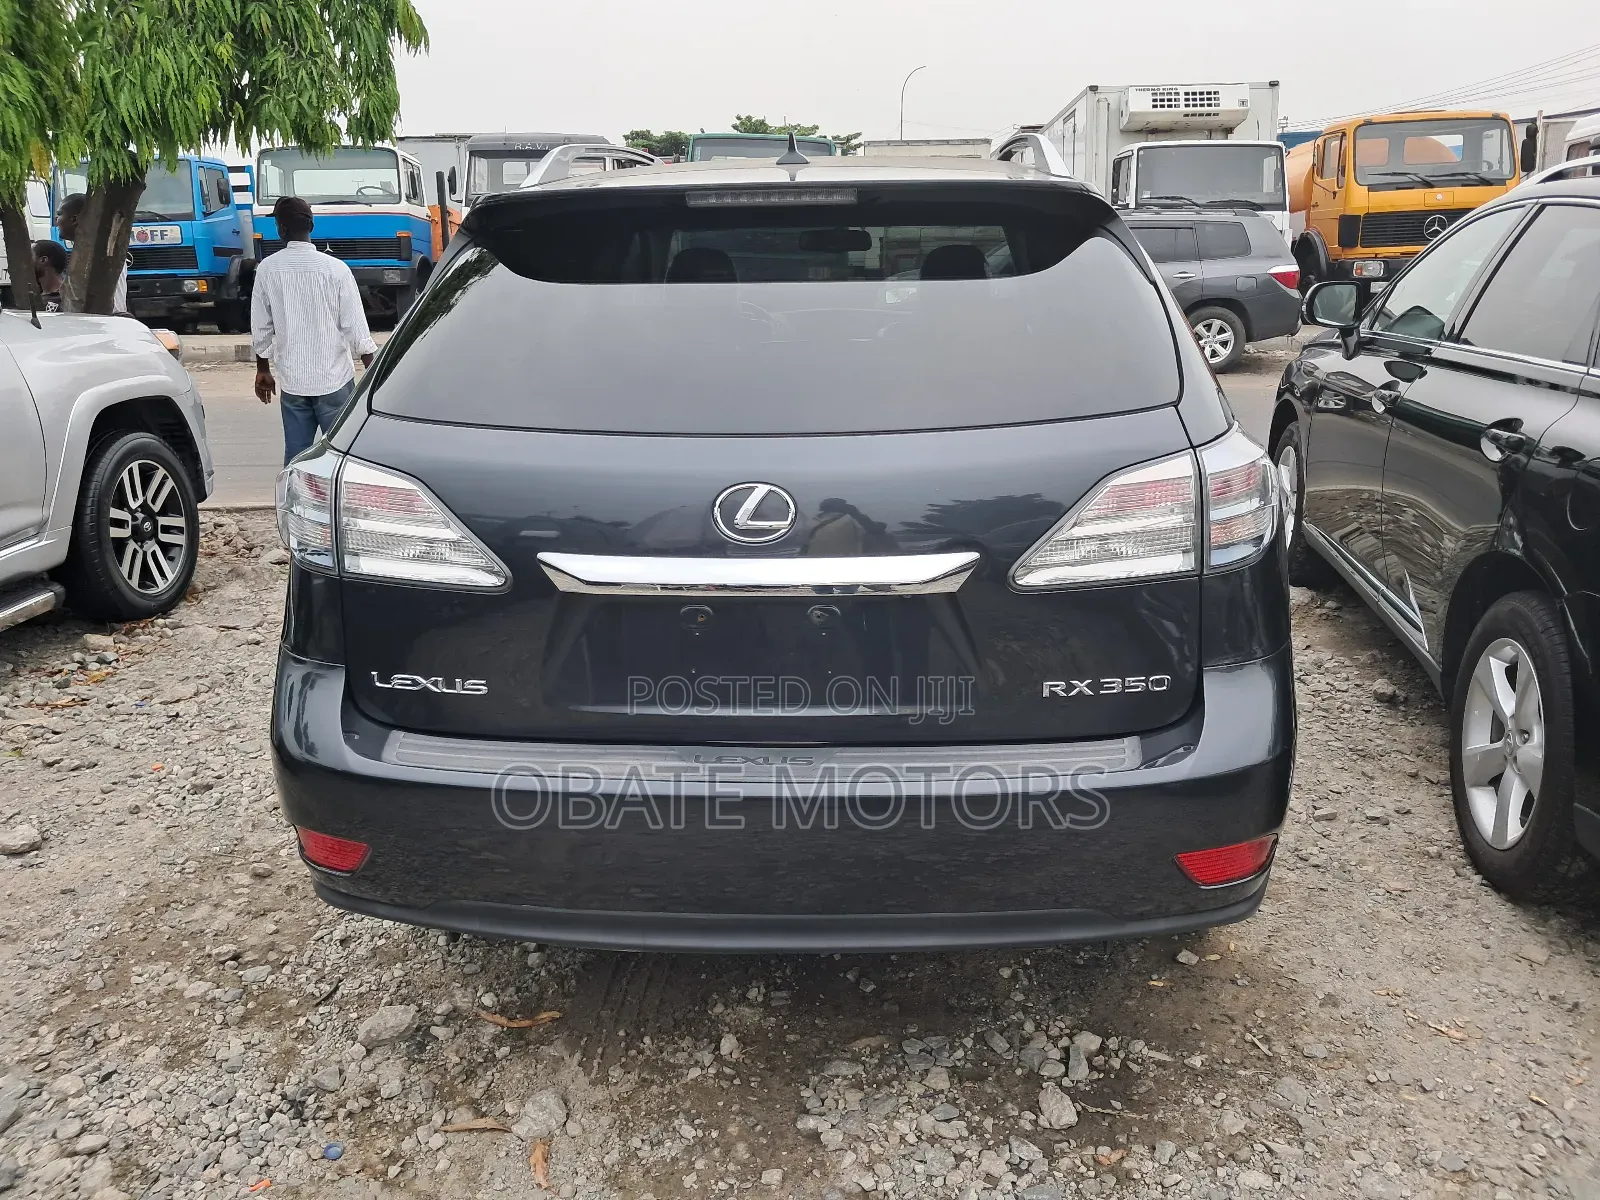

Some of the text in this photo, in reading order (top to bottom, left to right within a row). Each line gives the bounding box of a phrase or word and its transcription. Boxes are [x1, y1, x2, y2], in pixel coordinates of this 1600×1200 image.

[370, 671, 489, 695] LEXUS
[1042, 674, 1171, 698] RX 350
[693, 754, 814, 766] LEXUS
